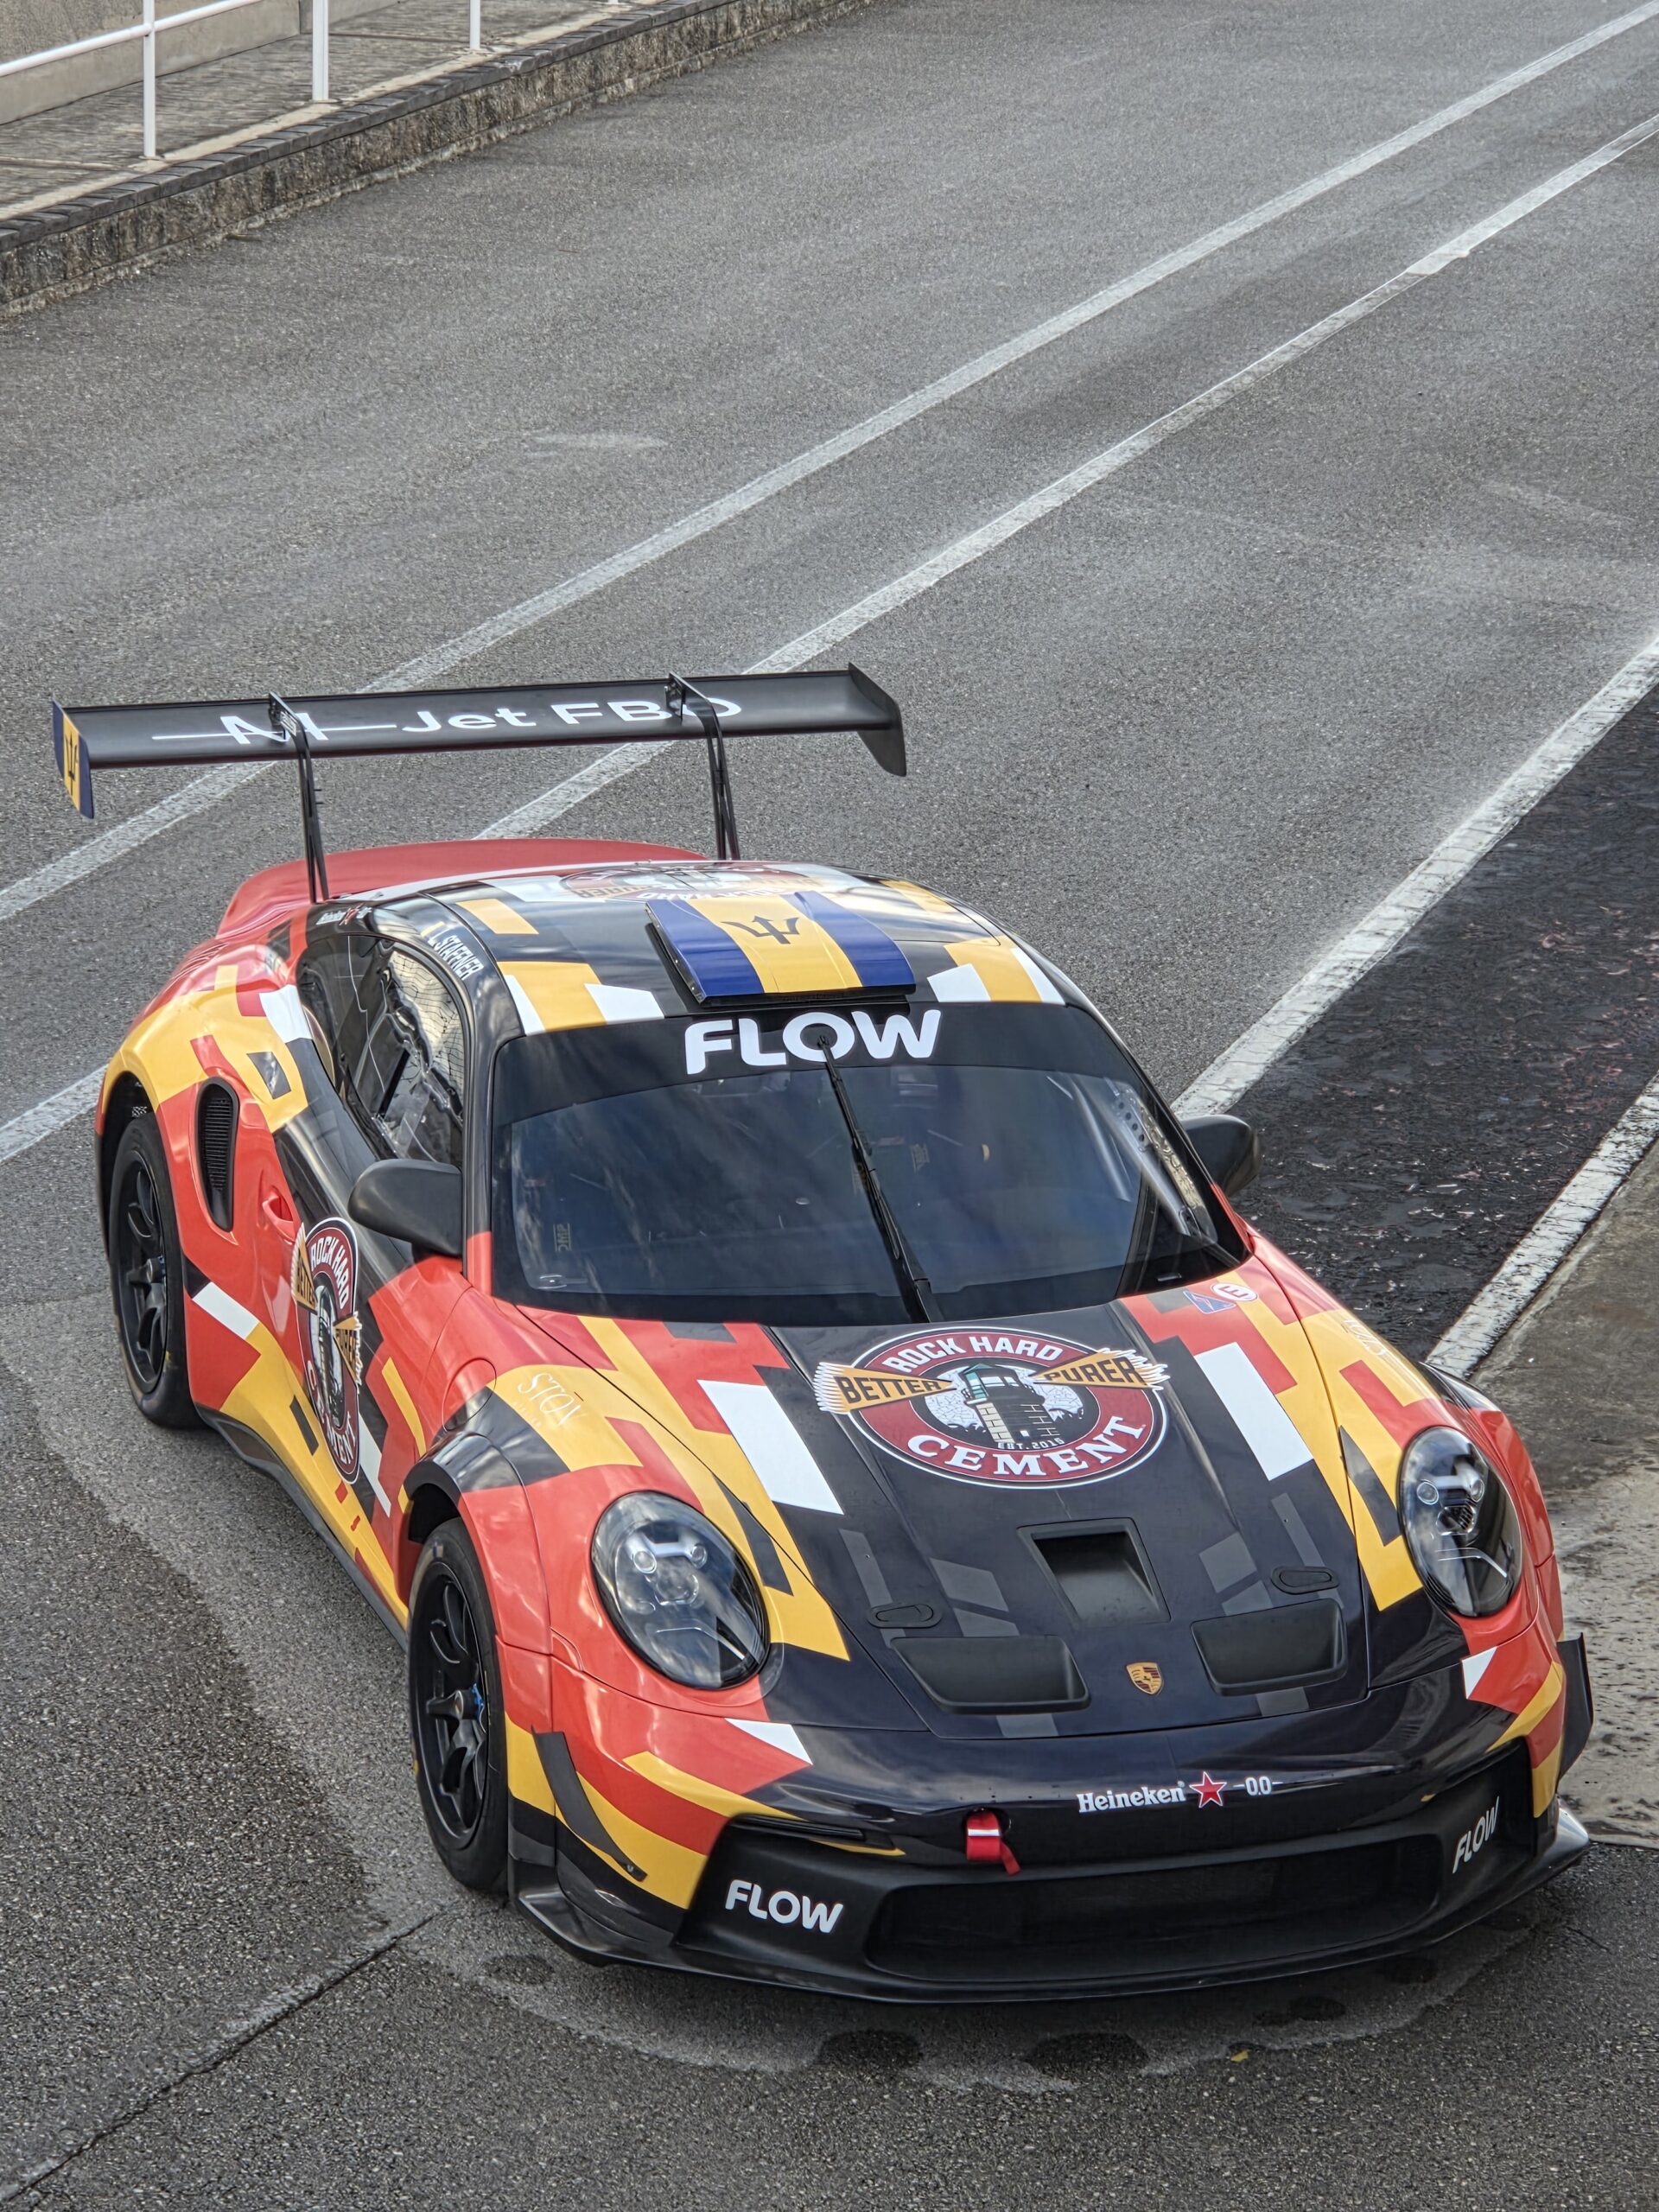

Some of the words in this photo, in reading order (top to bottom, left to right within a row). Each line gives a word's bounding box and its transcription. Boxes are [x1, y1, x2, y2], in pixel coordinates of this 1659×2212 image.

[684, 1009, 941, 1075] FLOW
[311, 1236, 339, 1272] ROCK
[331, 1244, 350, 1310] HARD
[1218, 1285, 1249, 1299] E
[881, 1336, 967, 1375] ROCK
[969, 1335, 1064, 1363] HARD
[1042, 1357, 1149, 1386] PURER
[833, 1374, 943, 1405] BETTER
[907, 1415, 1147, 1477] CEMENT
[1076, 1784, 1187, 1814] Heineken
[1452, 1795, 1500, 1874] FLOW
[725, 1878, 844, 1935] FLOW
